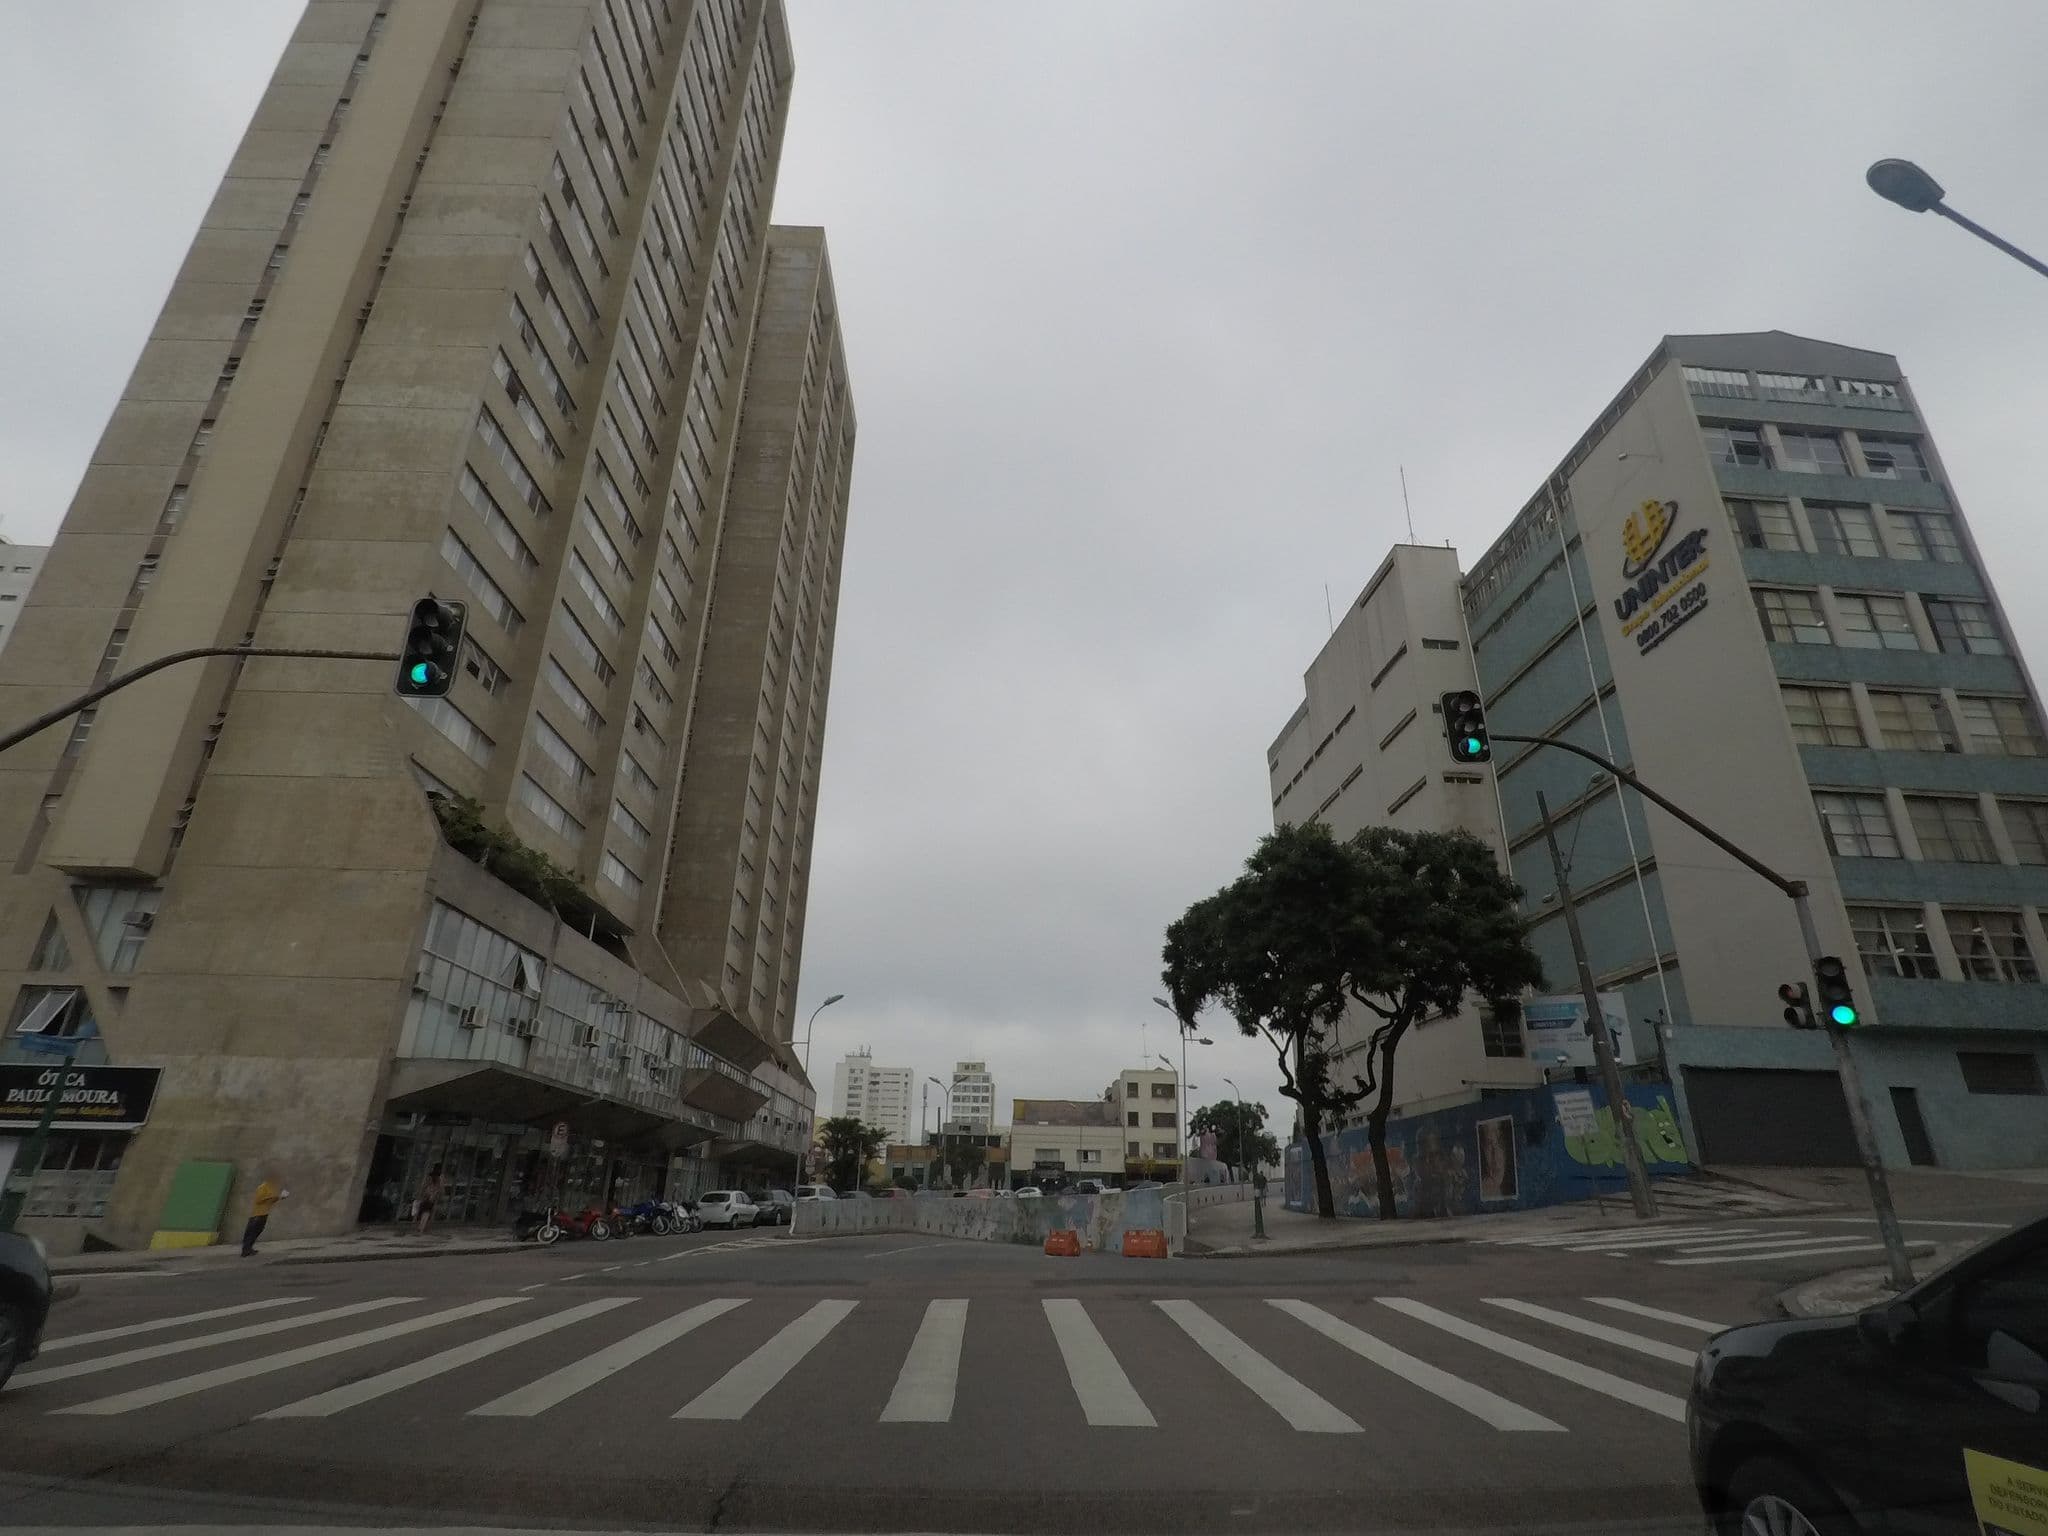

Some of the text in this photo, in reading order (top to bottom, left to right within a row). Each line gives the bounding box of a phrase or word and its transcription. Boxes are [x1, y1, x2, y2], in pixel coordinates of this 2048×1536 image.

[1614, 528, 1709, 620] UNINTER
[38, 1069, 86, 1086] ÓTCA
[60, 1089, 119, 1104] MOURA
